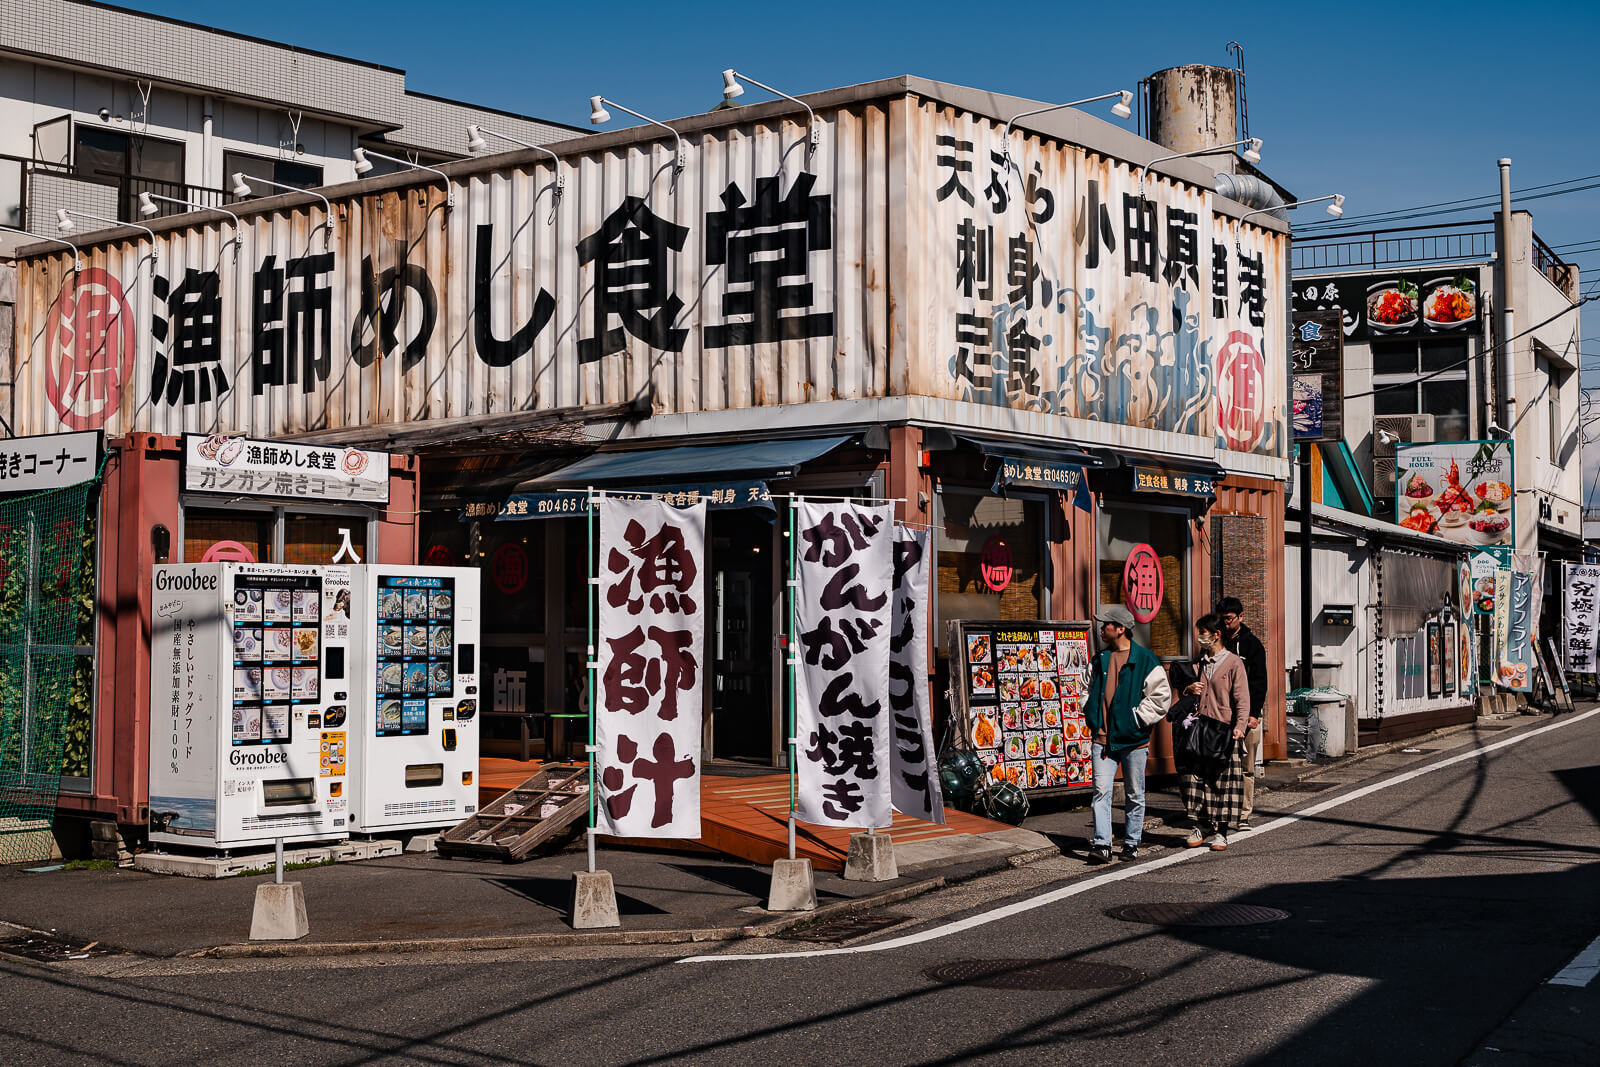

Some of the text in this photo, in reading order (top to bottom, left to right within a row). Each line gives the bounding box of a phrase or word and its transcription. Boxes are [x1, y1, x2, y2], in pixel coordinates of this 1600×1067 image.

[935, 133, 1055, 225] 天ぷら
[151, 171, 834, 406] 漁師めし食堂
[956, 217, 1042, 310] 刺身
[1292, 282, 1340, 301] 田原
[955, 308, 1041, 396] 定食
[200, 467, 377, 497] ガンガン焼きコーナー
[246, 445, 337, 470] 漁師めし食堂
[1138, 473, 1168, 489] 定食各種
[1174, 477, 1188, 492] 刺身
[465, 500, 528, 517] 漁師めし食堂
[657, 490, 699, 506] 食各種
[711, 489, 736, 504] 刺身
[156, 568, 217, 591] Groobee
[325, 578, 350, 586] Groobee
[1511, 575, 1529, 660] アジフライ
[801, 511, 887, 821] がんがん焼き
[1569, 580, 1597, 670] 究極の海鮮丼
[185, 618, 196, 759] やさしいドッグフード
[603, 518, 698, 829] 漁師汁
[230, 748, 288, 766] Groobee
